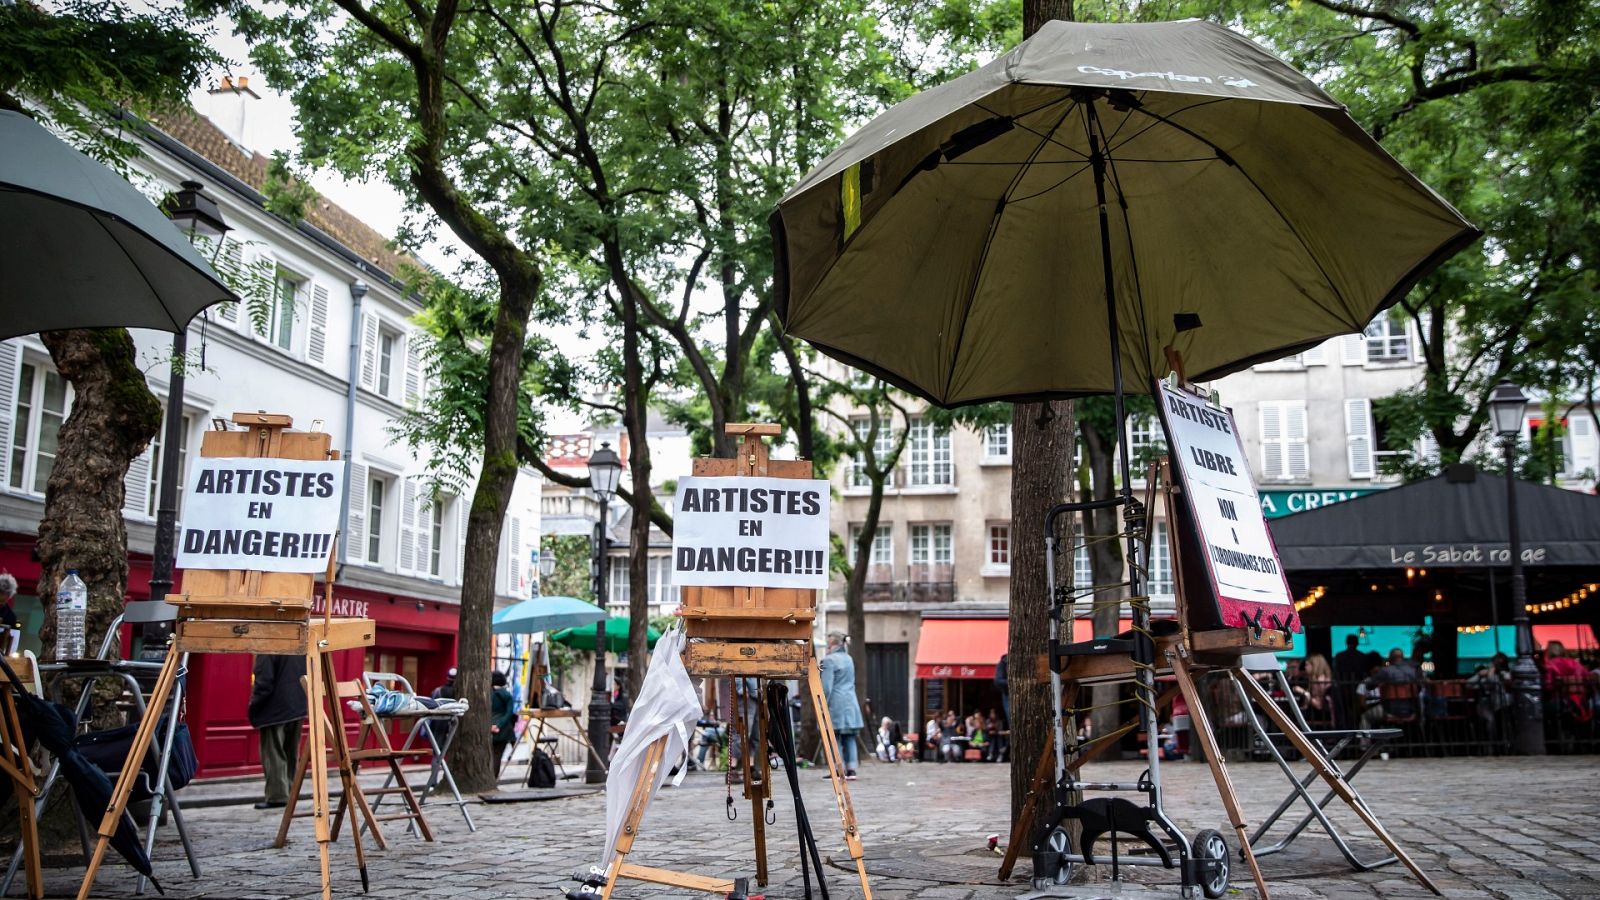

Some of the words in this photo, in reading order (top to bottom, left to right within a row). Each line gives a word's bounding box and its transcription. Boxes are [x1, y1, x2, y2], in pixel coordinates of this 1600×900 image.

[1167, 395, 1231, 435] ARTISTE
[1190, 446, 1238, 476] LIBRE
[195, 469, 334, 498] ARTISTES
[248, 502, 273, 519] EN
[681, 488, 821, 516] ARTISTES
[1217, 497, 1238, 521] NON
[739, 520, 763, 537] EN
[1231, 527, 1240, 545] A
[183, 528, 332, 559] DANGER!!!
[1390, 547, 1415, 563] Le
[1422, 545, 1484, 563] Sabot
[1489, 547, 1547, 564] roge
[676, 547, 824, 575] DANGER!!!
[1258, 555, 1278, 575] 2017
